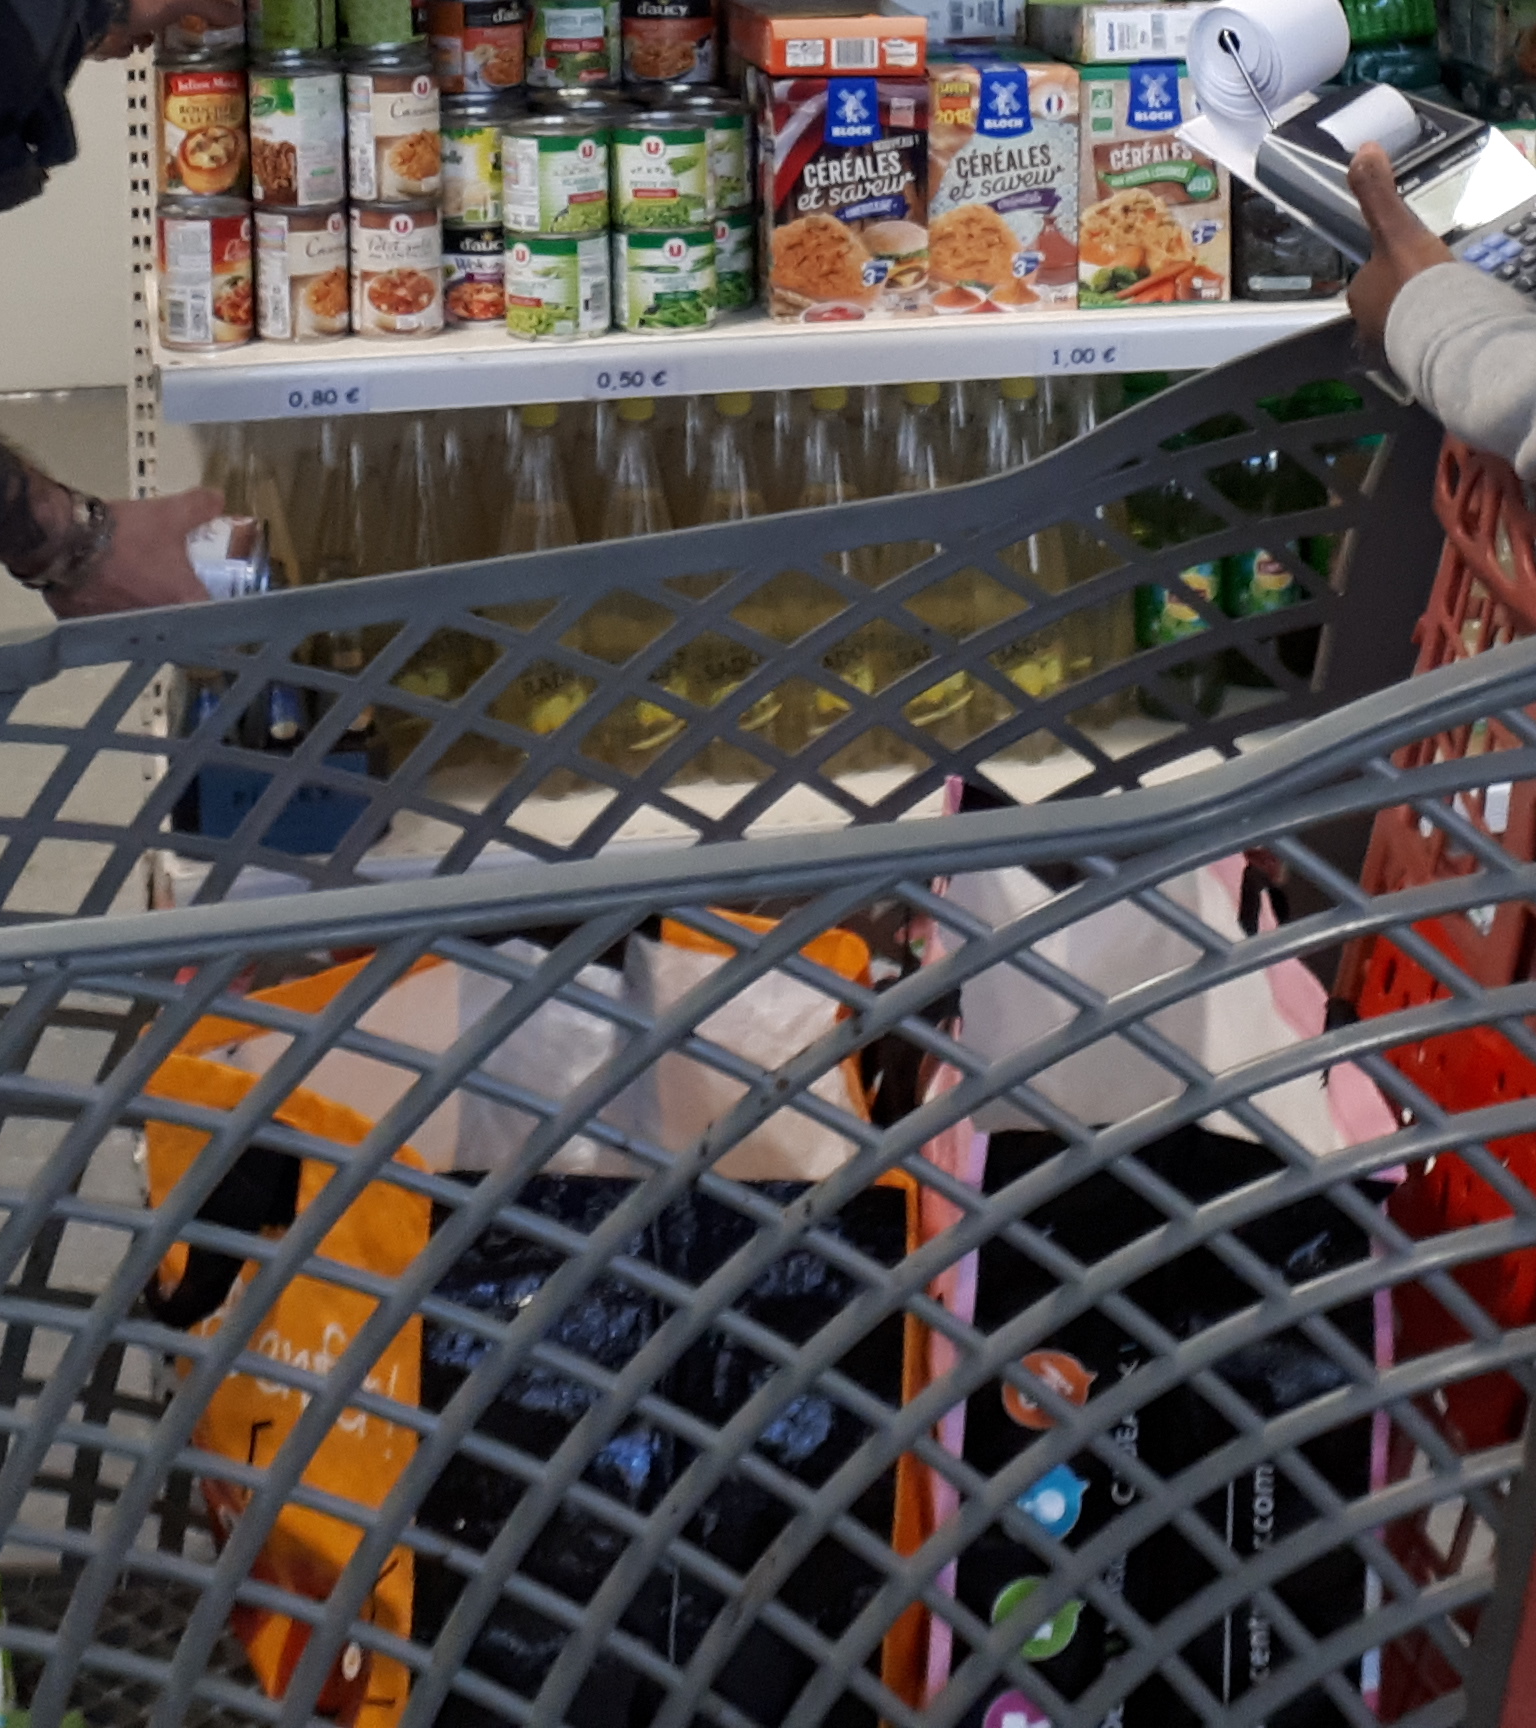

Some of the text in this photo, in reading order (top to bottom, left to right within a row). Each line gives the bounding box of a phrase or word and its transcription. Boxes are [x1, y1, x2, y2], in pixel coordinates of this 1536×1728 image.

[637, 2, 689, 18] d'aucy
[417, 79, 429, 94] U
[1133, 110, 1174, 122] BLOCH
[831, 125, 874, 138] BLOCH
[983, 118, 1025, 130] BLOCH
[582, 145, 594, 158] U
[645, 140, 661, 155] U
[956, 144, 1052, 180] CÉRÉALES
[1109, 140, 1193, 171] CÉRÉALES
[803, 150, 902, 189] CÉRÉALES
[949, 164, 1066, 202] et saveur
[797, 186, 825, 211] et
[828, 171, 917, 207] saveur
[330, 219, 341, 232] U
[394, 218, 410, 233] U
[460, 237, 504, 253] d'auc
[668, 243, 683, 258] U
[515, 248, 527, 263] U
[1051, 347, 1116, 367] 1,00 €
[597, 370, 668, 392] 0,50 €
[289, 387, 360, 409] 0,80 €
